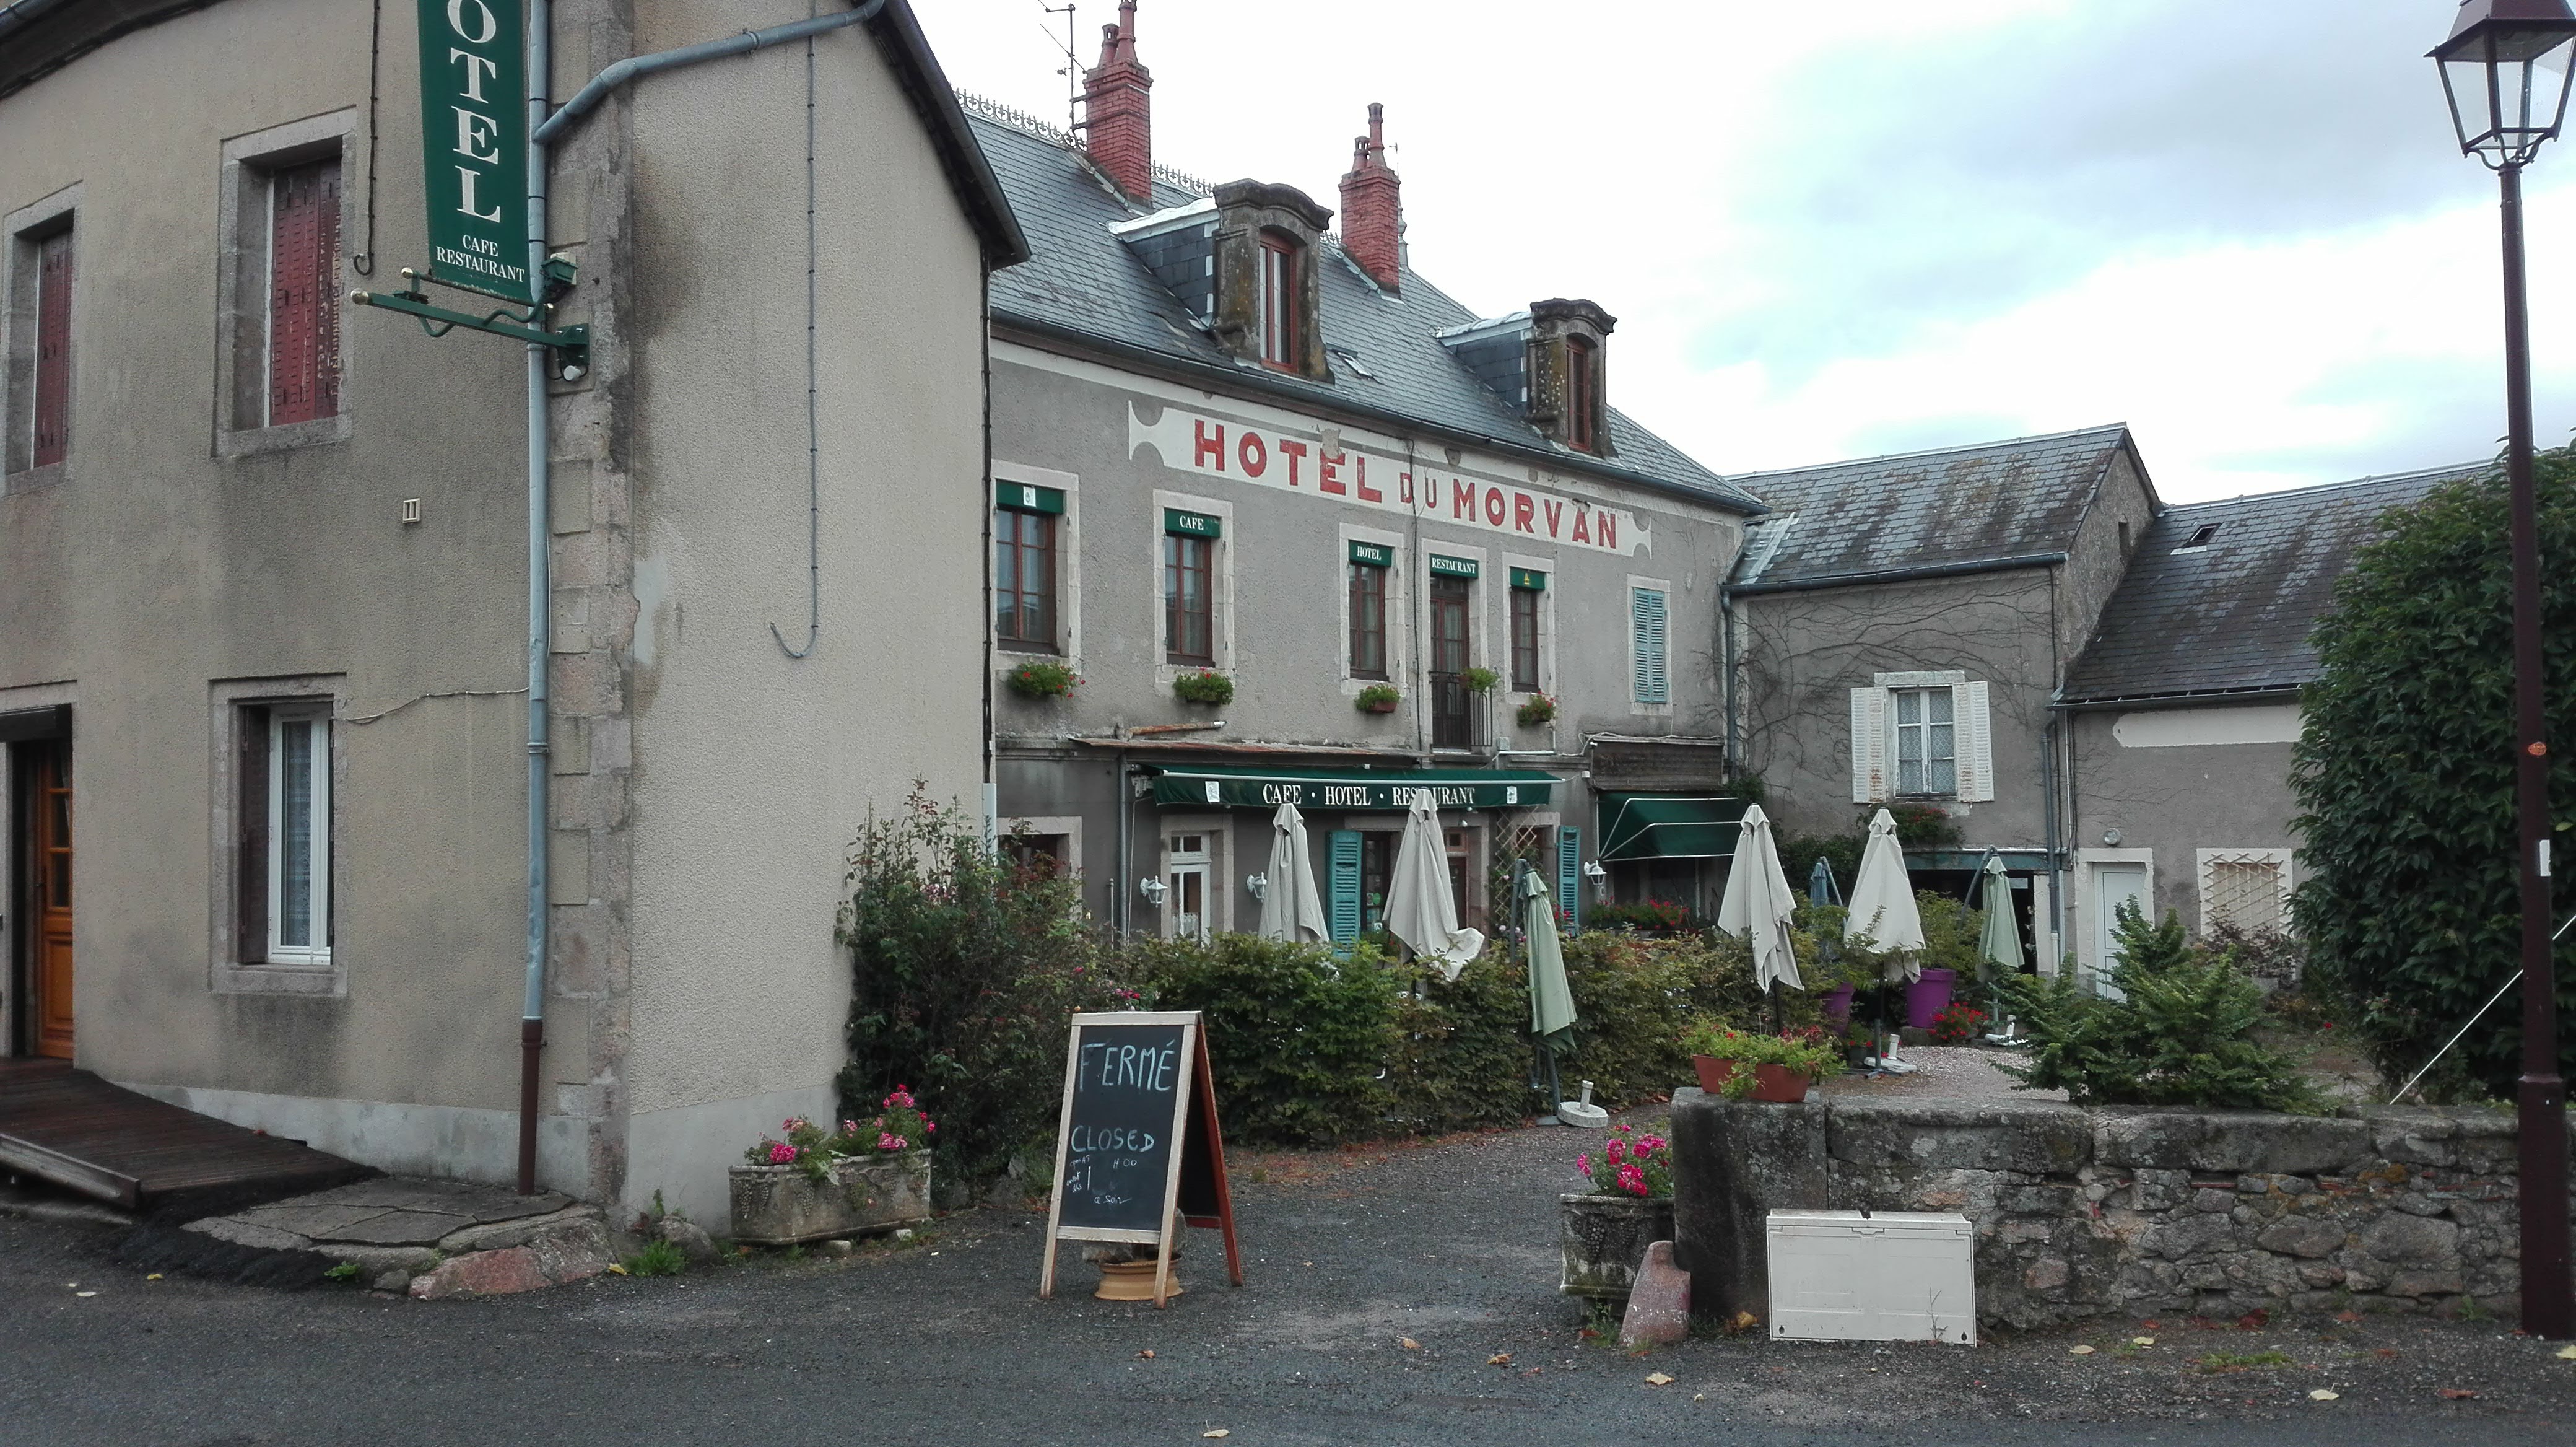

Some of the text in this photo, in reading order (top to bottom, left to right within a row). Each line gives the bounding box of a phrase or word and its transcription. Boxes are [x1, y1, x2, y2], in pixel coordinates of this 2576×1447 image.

[463, 234, 498, 257] CAFE
[436, 246, 525, 282] RESTAURANT
[1194, 419, 1617, 549] HOTEL DU MORVAN
[1180, 515, 1204, 531] CAFE
[1357, 546, 1382, 561] HOTEL
[1432, 557, 1476, 574] RESTAURANT
[1263, 784, 1475, 805] CAFE HOTEL RESURANT
[1079, 1039, 1175, 1092] FERMÉ
[1071, 1125, 1155, 1152] CLOSED
